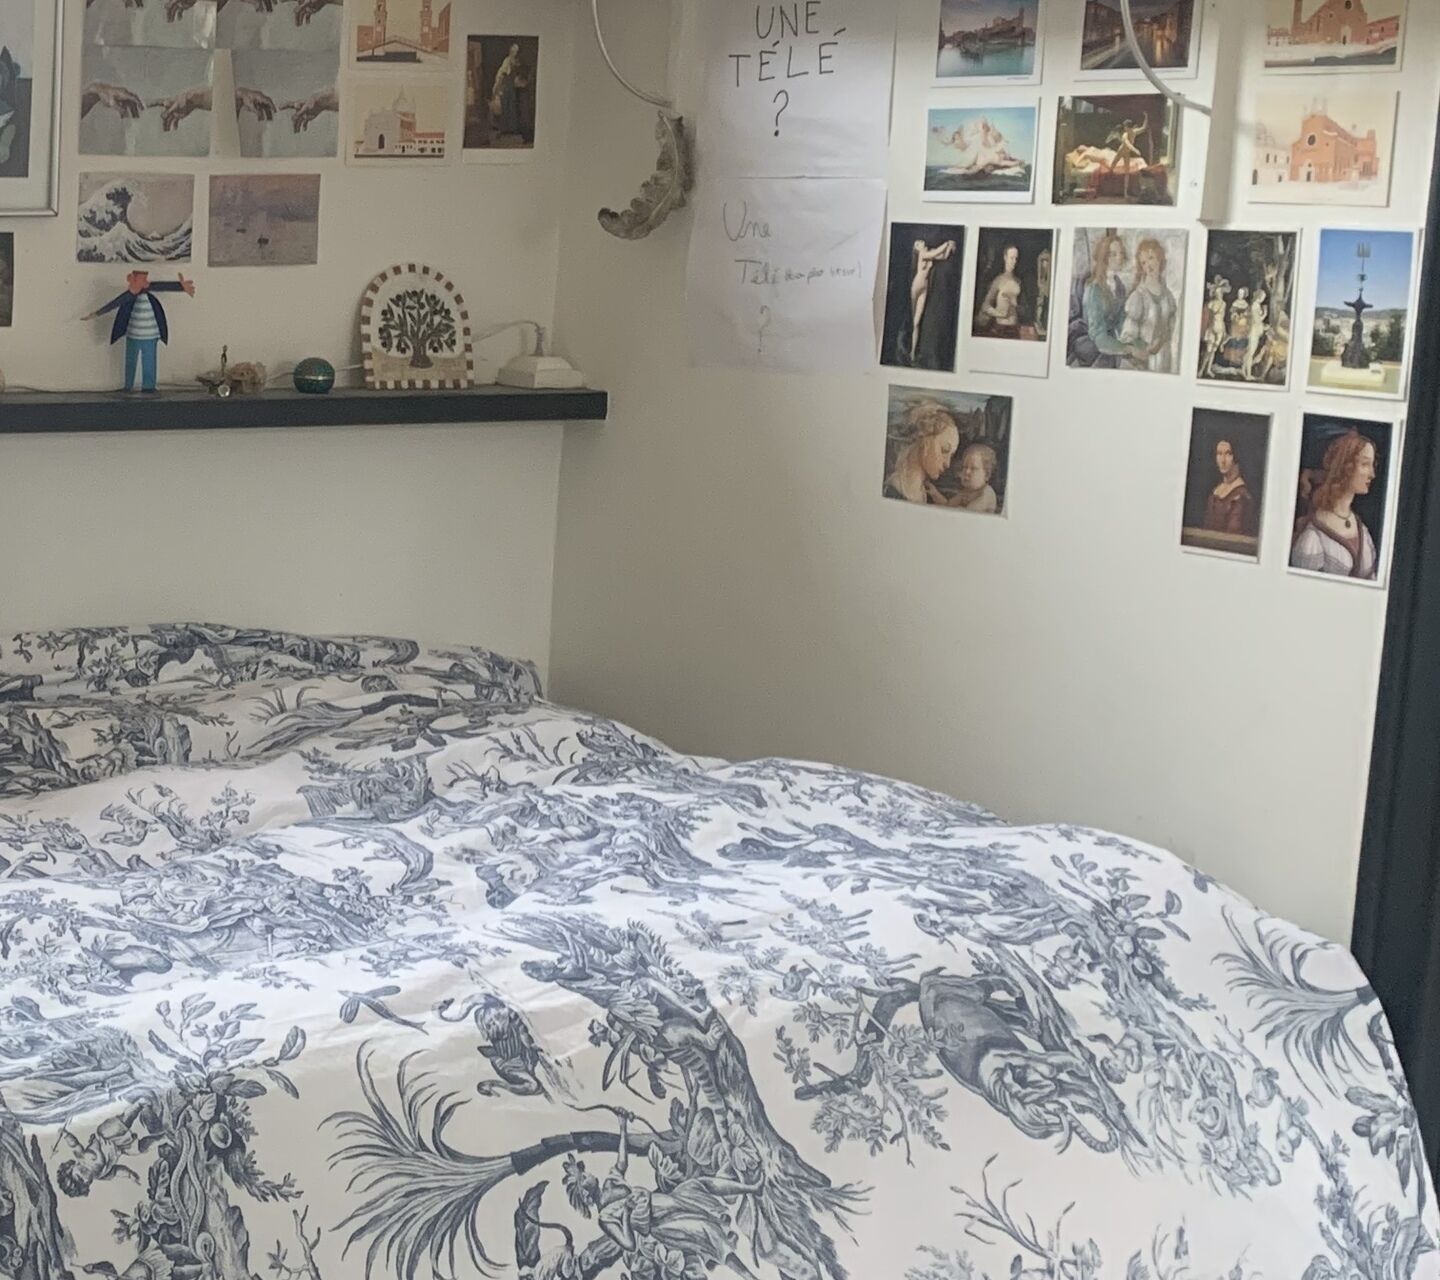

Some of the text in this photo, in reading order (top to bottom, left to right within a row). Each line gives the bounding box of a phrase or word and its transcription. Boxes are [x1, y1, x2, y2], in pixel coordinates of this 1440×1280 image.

[755, 0, 822, 39] UNE
[727, 27, 847, 88] TÉLÉ
[773, 88, 790, 137] ?
[722, 200, 772, 243] Une
